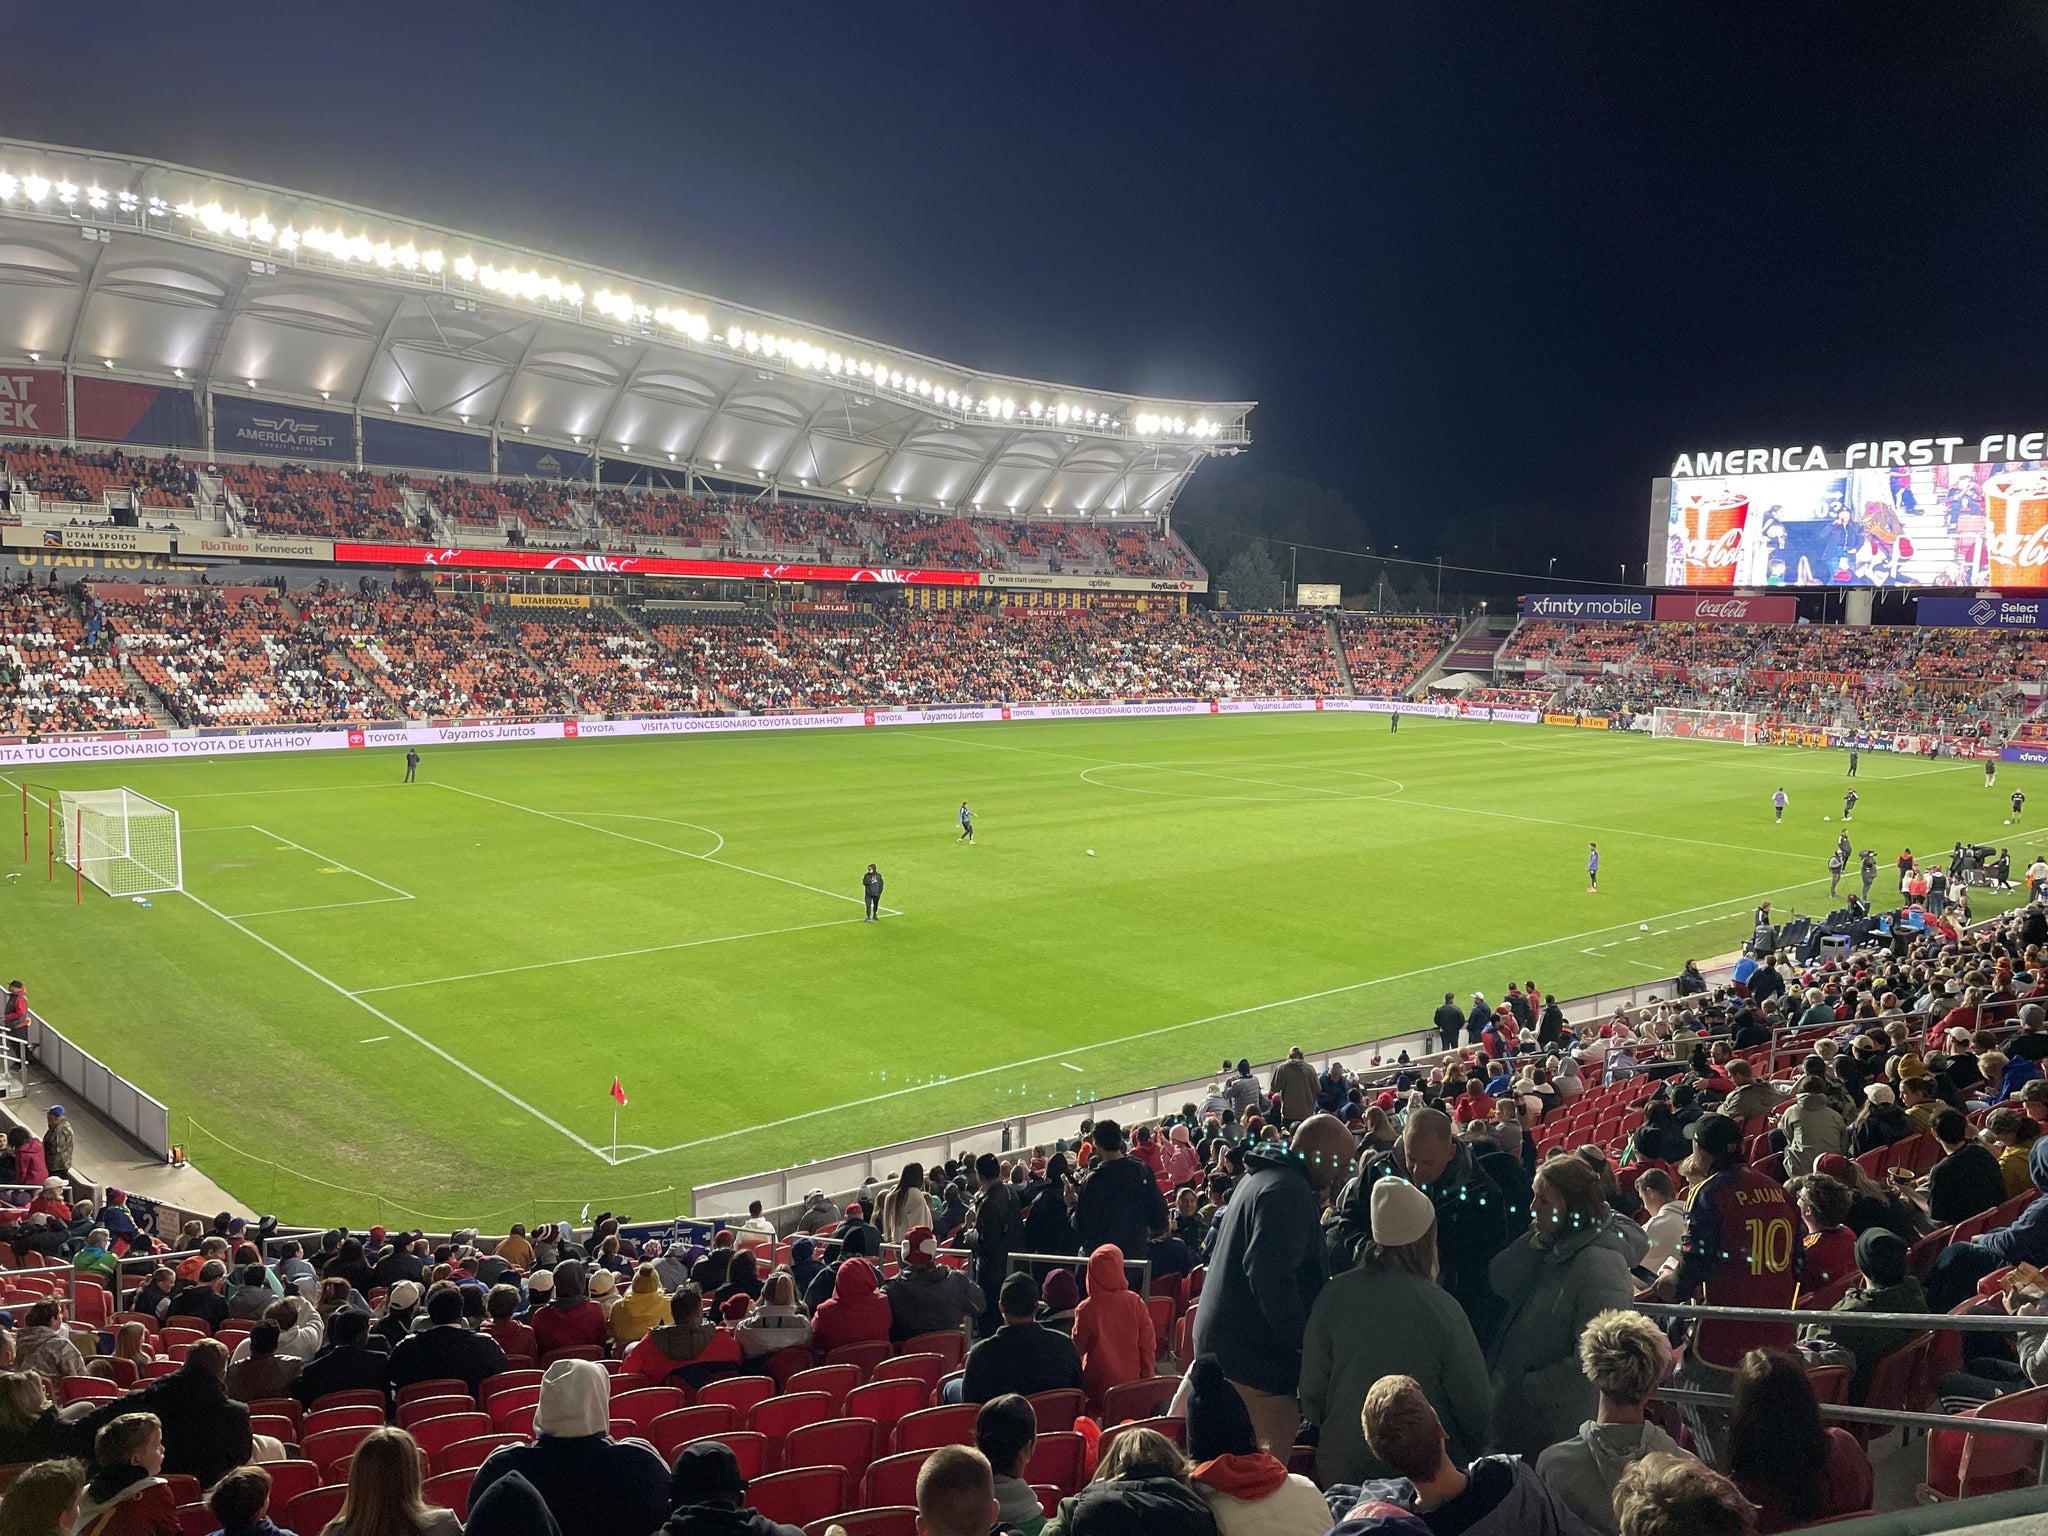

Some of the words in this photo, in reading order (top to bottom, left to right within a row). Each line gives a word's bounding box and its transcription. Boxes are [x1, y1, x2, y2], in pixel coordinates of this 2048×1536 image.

[236, 428, 296, 445] AMERICA
[298, 435, 335, 448] FIRST
[1670, 445, 1830, 478] AMERICA
[1845, 437, 1964, 469] FIRST
[1979, 432, 2048, 463] FIE
[66, 532, 95, 541] UTAH
[98, 533, 137, 542] SPORTS
[67, 541, 137, 551] COMMISSION
[255, 542, 314, 555] Kennecott
[18, 550, 95, 568] UTAH
[1028, 577, 1053, 585] UNIVERSITY
[1088, 578, 1111, 588] aptive
[1151, 581, 1179, 590] KeyBank
[520, 596, 544, 606] UTAH
[546, 596, 580, 607] ROYALS
[1307, 591, 1331, 600] Ford
[1532, 597, 1584, 616] xfinity
[1586, 598, 1642, 615] mobile
[2001, 602, 2039, 613] Select
[1239, 614, 1262, 622] UTAH
[2000, 613, 2036, 624] Health
[1788, 672, 1799, 681] LA
[1802, 672, 1833, 683] BARRA
[1835, 673, 1858, 684] REAL
[1050, 708, 1069, 716] VISITA
[1079, 706, 1131, 715] CONCESIONARIO
[1132, 705, 1156, 713] TOYOTA
[1182, 704, 1195, 712] HOY
[1253, 702, 1280, 711] Vayamos
[1281, 701, 1302, 710] Juntos
[1368, 702, 1391, 710] VISITA
[1496, 711, 1514, 719] UTAH
[1514, 712, 1531, 720] HOY
[876, 714, 903, 722] TOYOTA
[921, 711, 956, 722] Vayamos
[957, 710, 984, 720] Juntos
[580, 724, 615, 734] TOYOTA
[641, 722, 670, 732] VISITA
[671, 721, 682, 731] TU
[683, 718, 757, 730] CONCESIONARIO
[758, 717, 791, 728] TOYOTA
[791, 717, 802, 727] DE
[803, 716, 822, 726] UTAH
[822, 715, 844, 725] HOY
[367, 733, 408, 743] TOYOTA
[439, 728, 494, 741] Vayamos
[495, 726, 536, 738] Juntos
[25, 748, 45, 759] TU
[49, 743, 170, 759] CONCESIONARIO
[172, 741, 226, 753] TOYOTA
[229, 740, 245, 750] DE
[248, 737, 283, 749] UTAH
[286, 736, 312, 747] HOY
[2019, 752, 2047, 763] xfinity
[1744, 1217, 1793, 1276] 10
